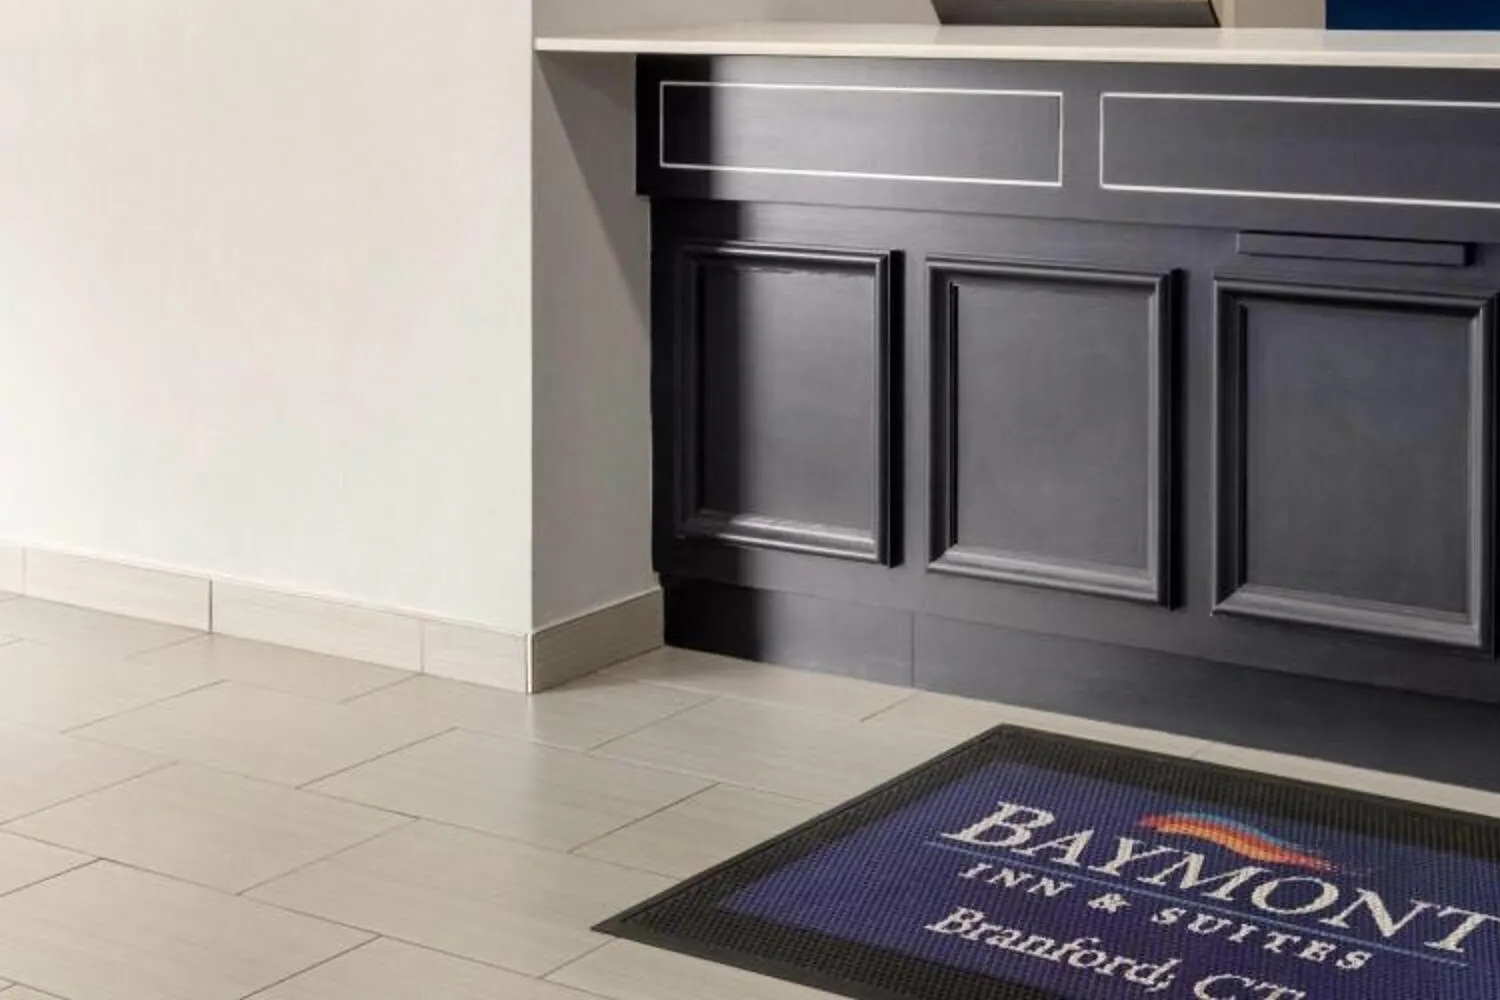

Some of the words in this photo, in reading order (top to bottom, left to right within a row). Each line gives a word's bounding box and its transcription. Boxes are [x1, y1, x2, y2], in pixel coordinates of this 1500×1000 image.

[924, 906, 1183, 993] Branford,
[958, 863, 1075, 897] INN
[1087, 894, 1131, 913] &
[1151, 907, 1372, 971] SUITES
